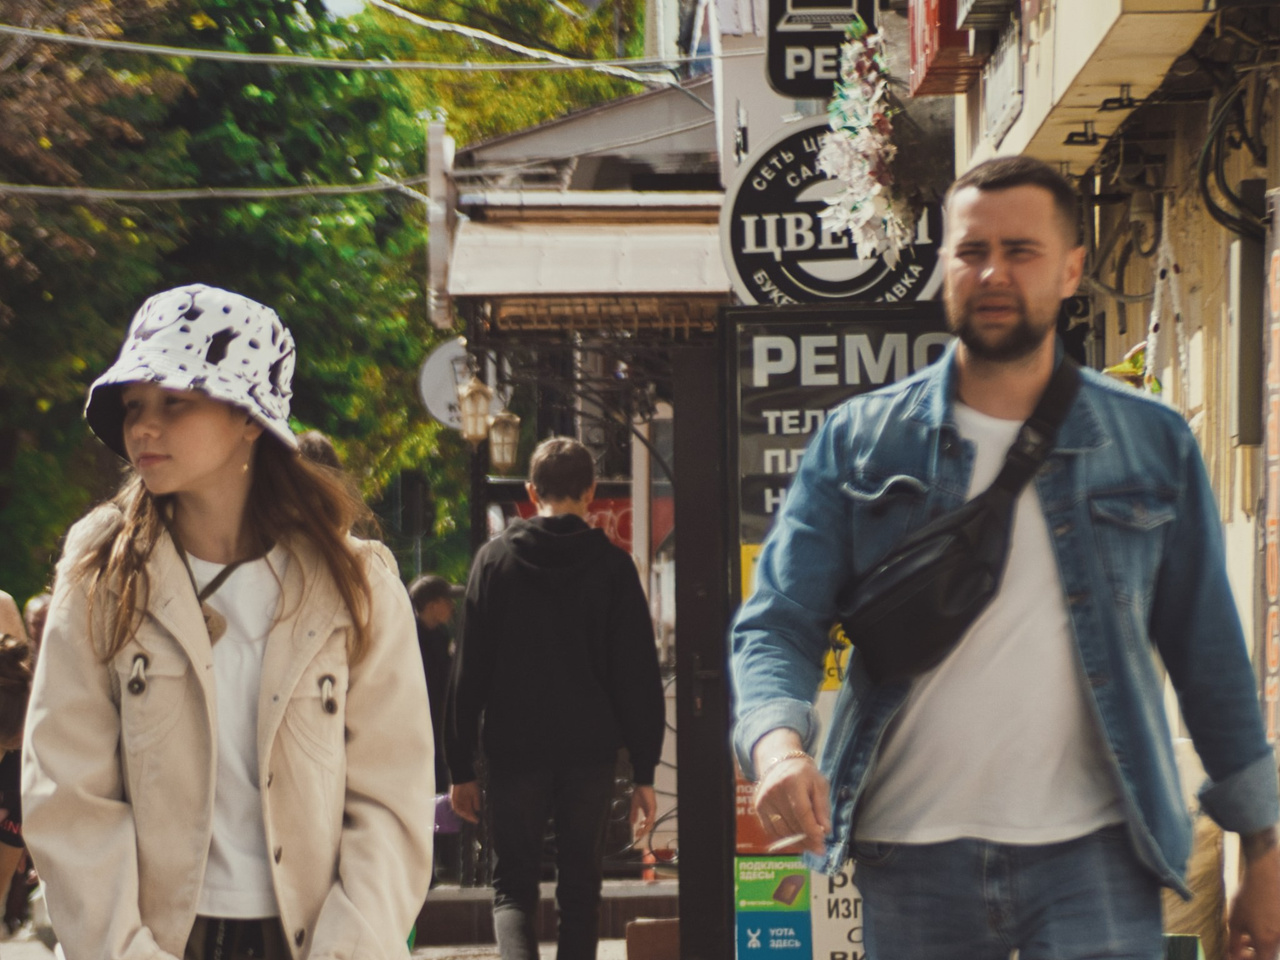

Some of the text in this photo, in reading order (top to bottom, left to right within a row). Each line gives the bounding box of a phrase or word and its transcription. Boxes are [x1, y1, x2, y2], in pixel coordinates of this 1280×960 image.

[752, 150, 795, 191] СЕТЬ
[877, 265, 924, 303] АВКА
[762, 409, 832, 435] ТЕЛ
[769, 939, 801, 948] ЗДЕСЬ
